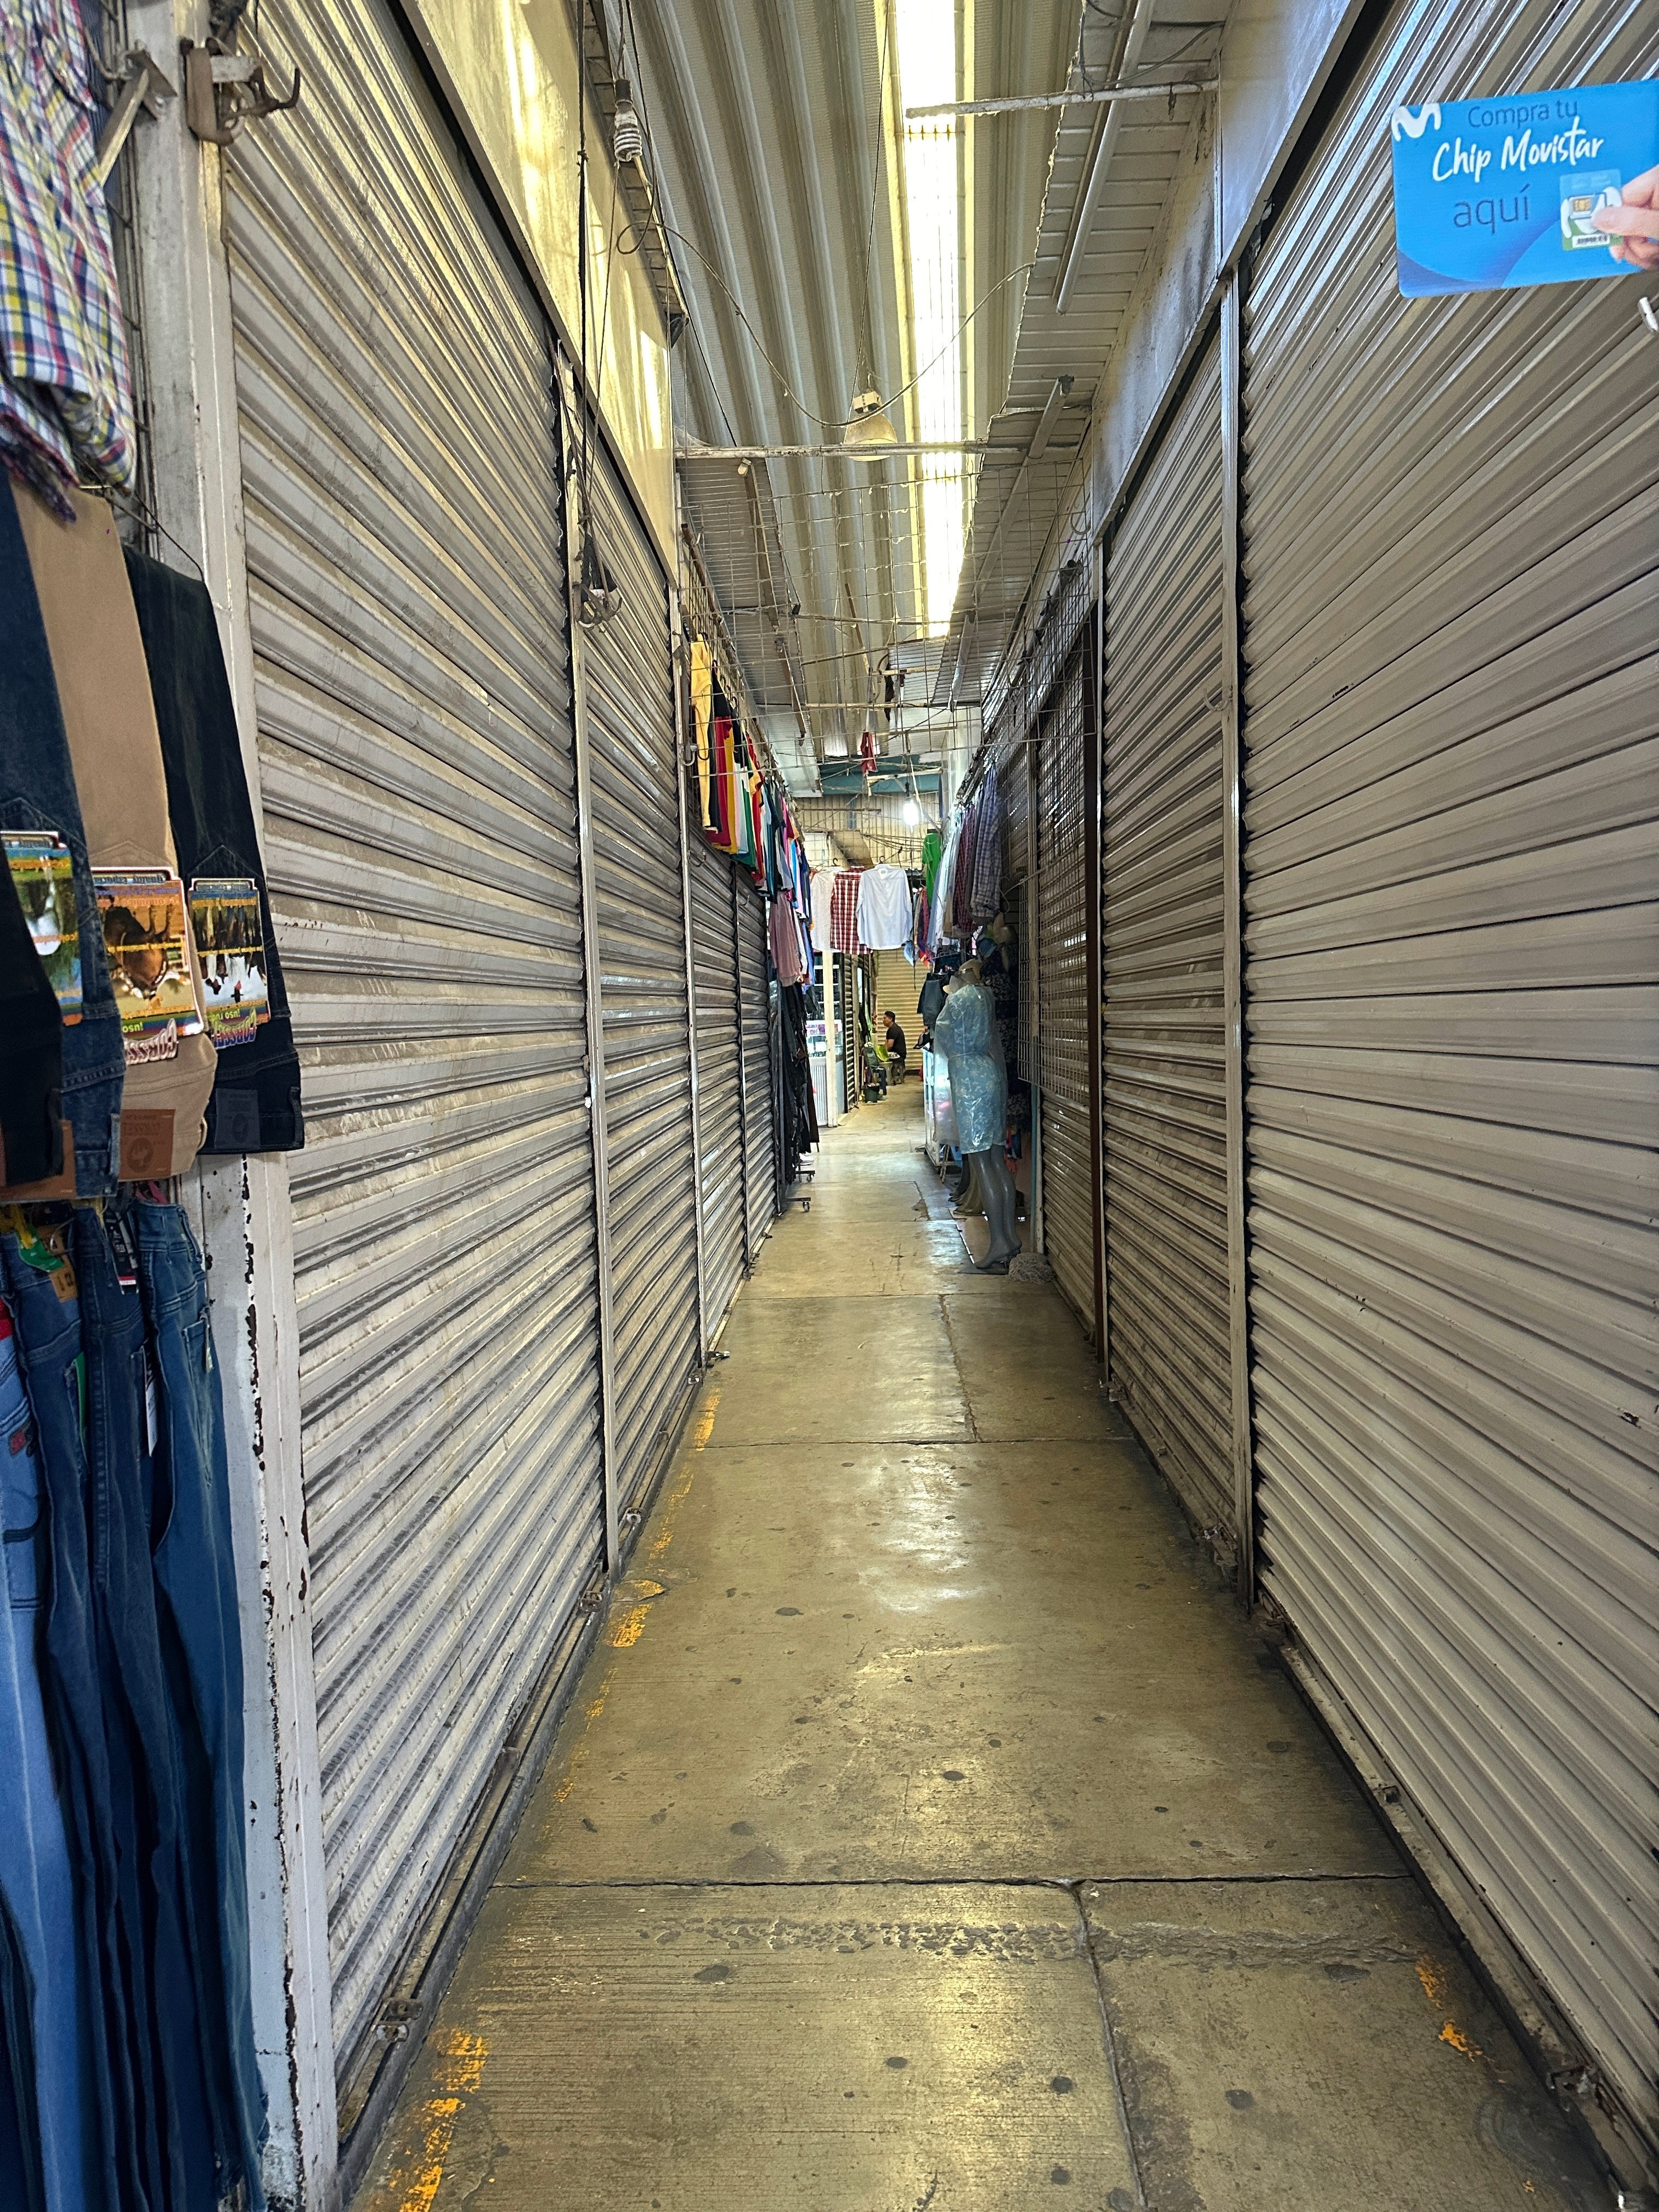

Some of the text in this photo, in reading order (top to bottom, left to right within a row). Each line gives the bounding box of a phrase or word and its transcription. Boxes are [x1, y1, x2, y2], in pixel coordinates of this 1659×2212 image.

[1468, 99, 1579, 129] Compra tu
[1432, 115, 1604, 183] Chip Movistar
[1453, 182, 1531, 235] aquí
